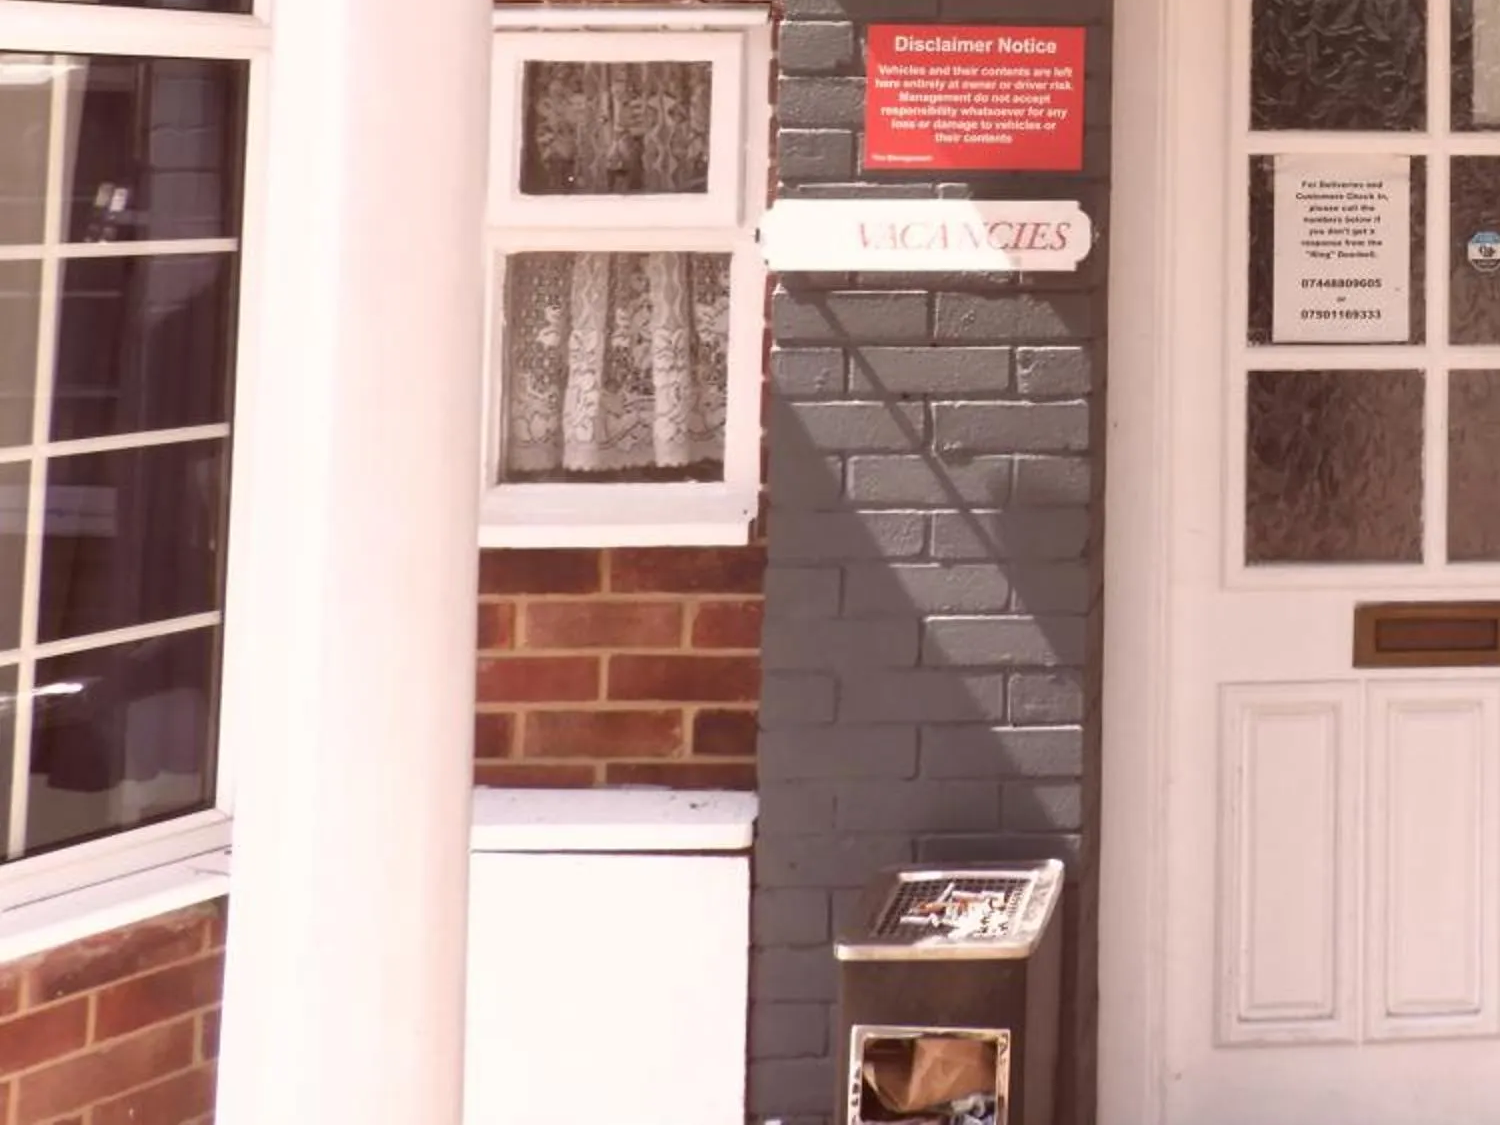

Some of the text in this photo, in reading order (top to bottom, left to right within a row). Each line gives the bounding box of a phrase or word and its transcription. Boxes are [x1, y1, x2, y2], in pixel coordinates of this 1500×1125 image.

[895, 36, 1057, 54] Disclaimer Notice
[878, 65, 1072, 77] Vehicles and their contents are left
[875, 79, 900, 88] here
[903, 79, 945, 90] entirely
[948, 79, 959, 89] at
[1014, 80, 1047, 90] driver
[899, 93, 1051, 104] Management do not accept
[880, 105, 1067, 119] responsibility whatsoever for any
[892, 119, 1056, 130] loss or damage to vehicles or
[935, 133, 961, 142] their
[859, 222, 1070, 251] VACANCIES
